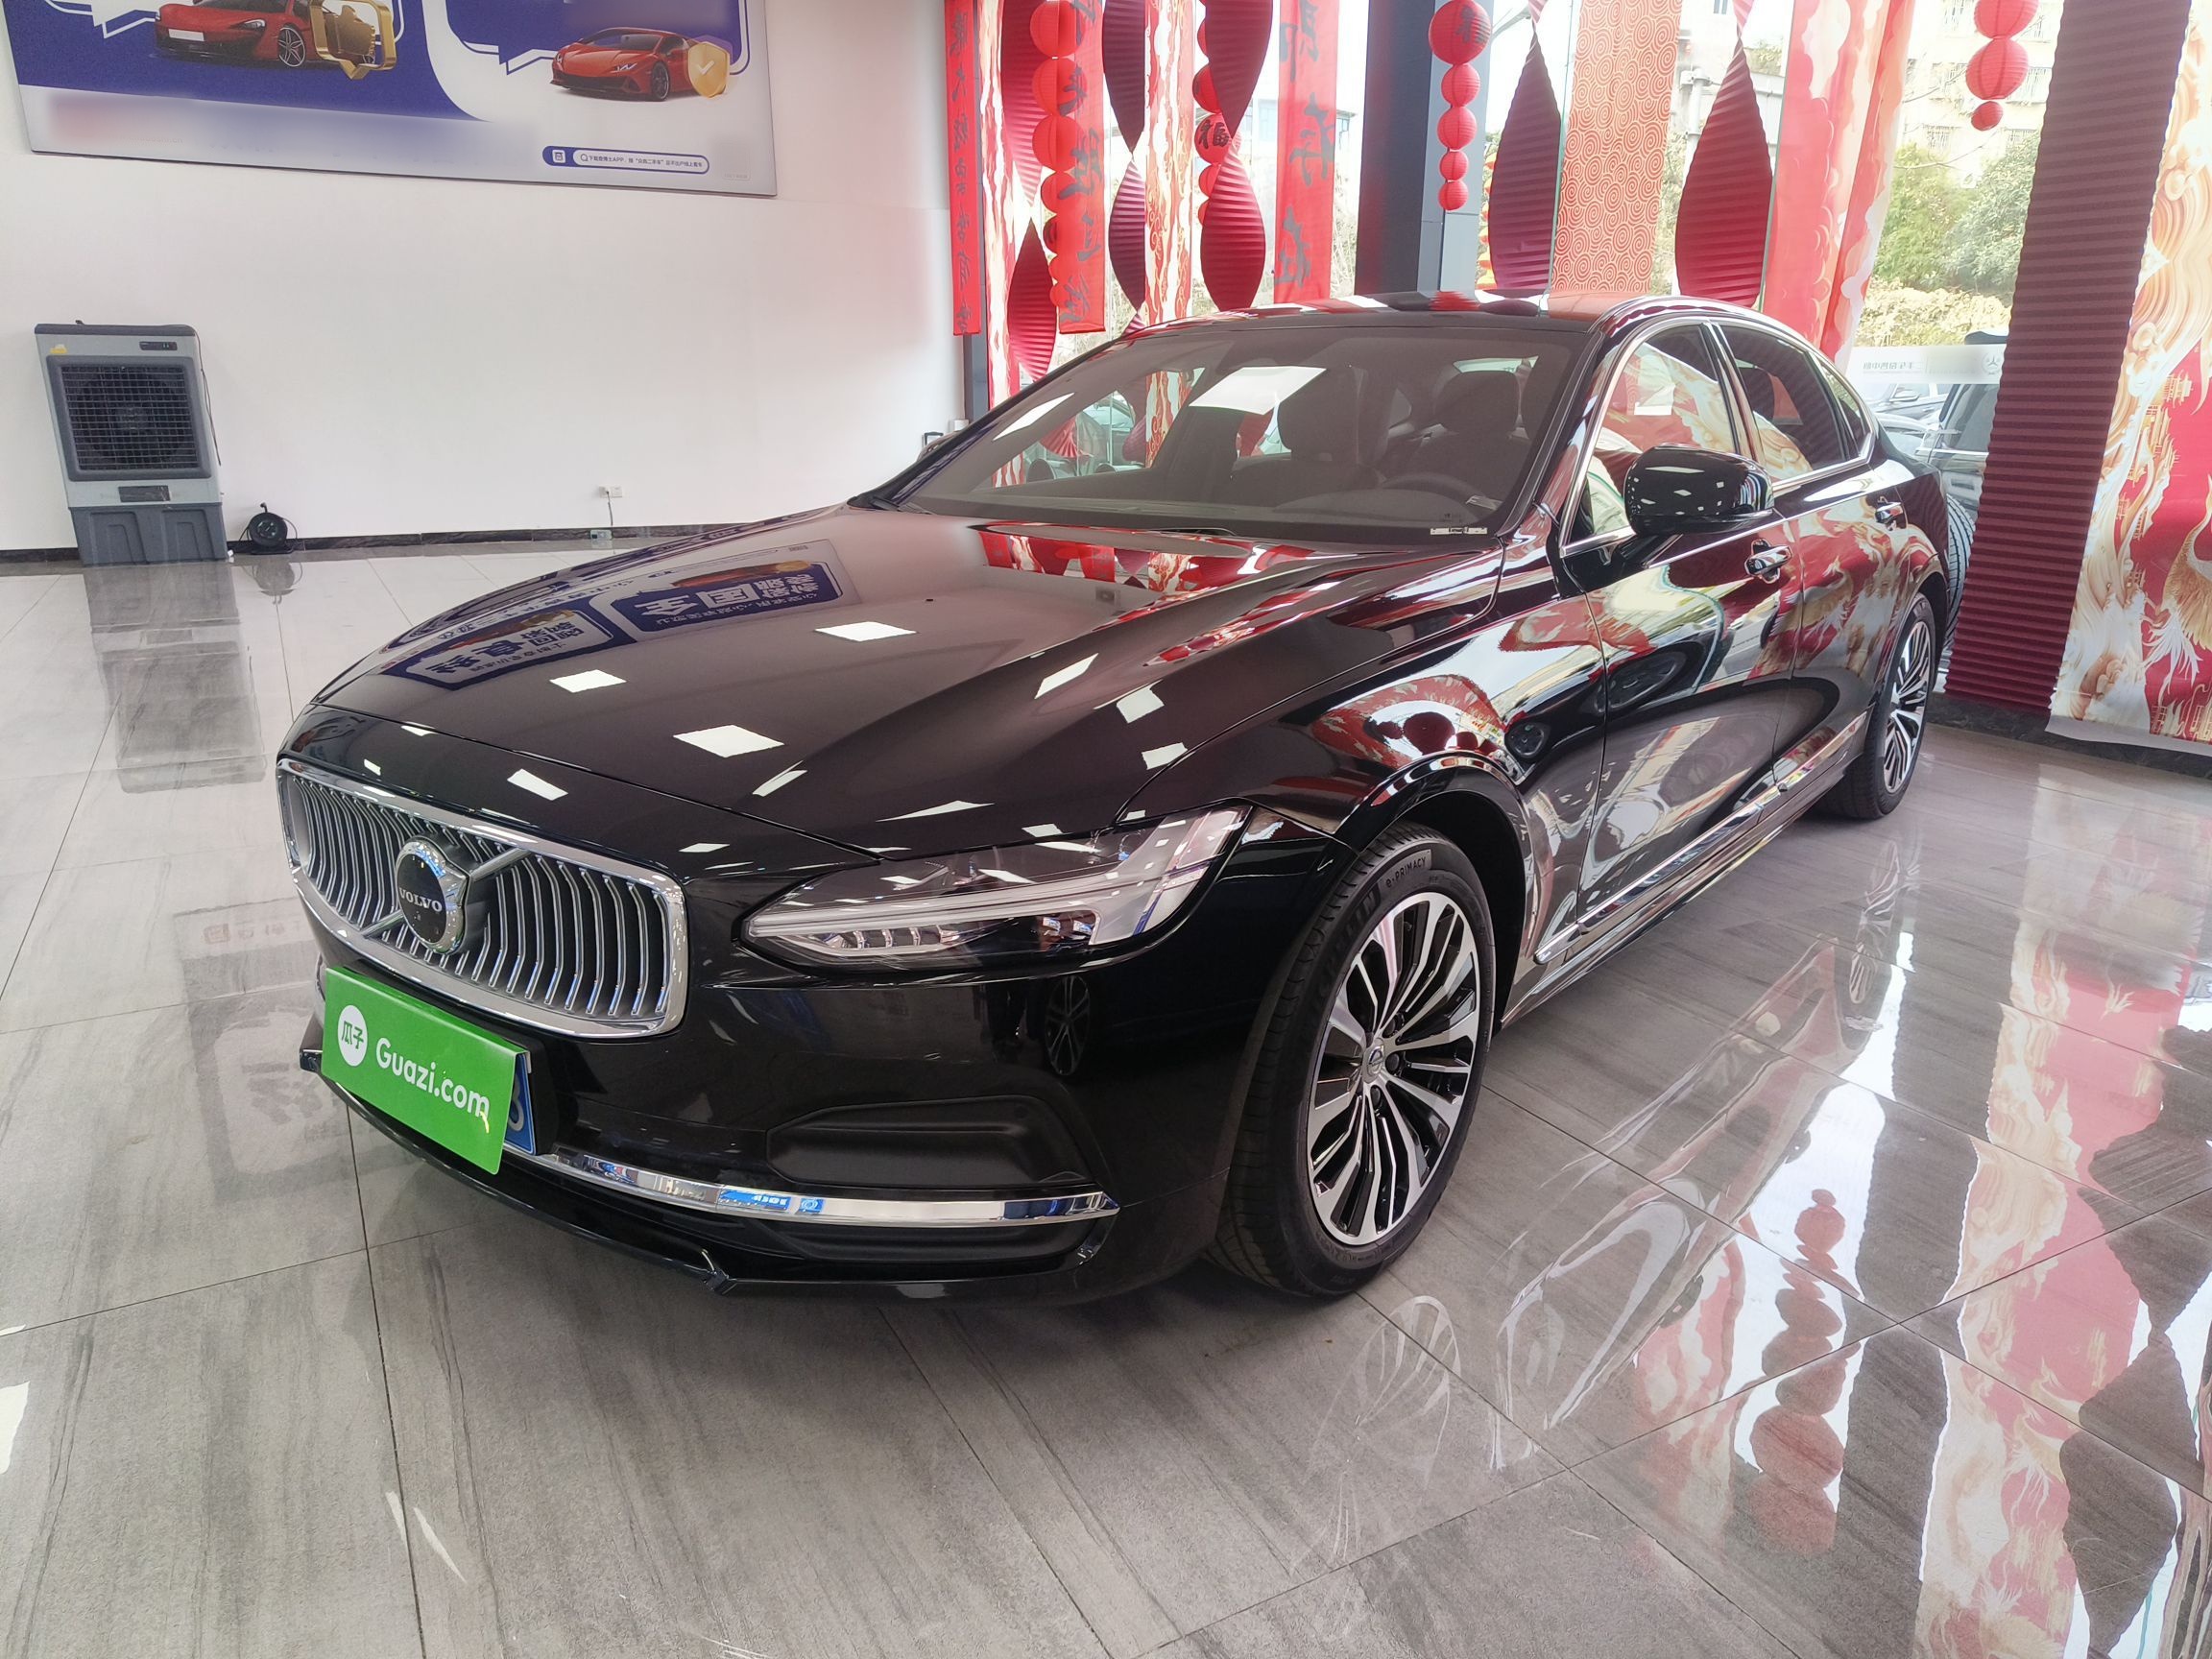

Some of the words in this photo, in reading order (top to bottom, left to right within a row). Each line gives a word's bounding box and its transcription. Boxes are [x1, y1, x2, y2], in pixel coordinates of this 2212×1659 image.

[1198, 119, 1230, 150] 福
[398, 887, 443, 912] VOLVO
[341, 1021, 365, 1050] 瓜子
[375, 1037, 490, 1118] Guazi.com
